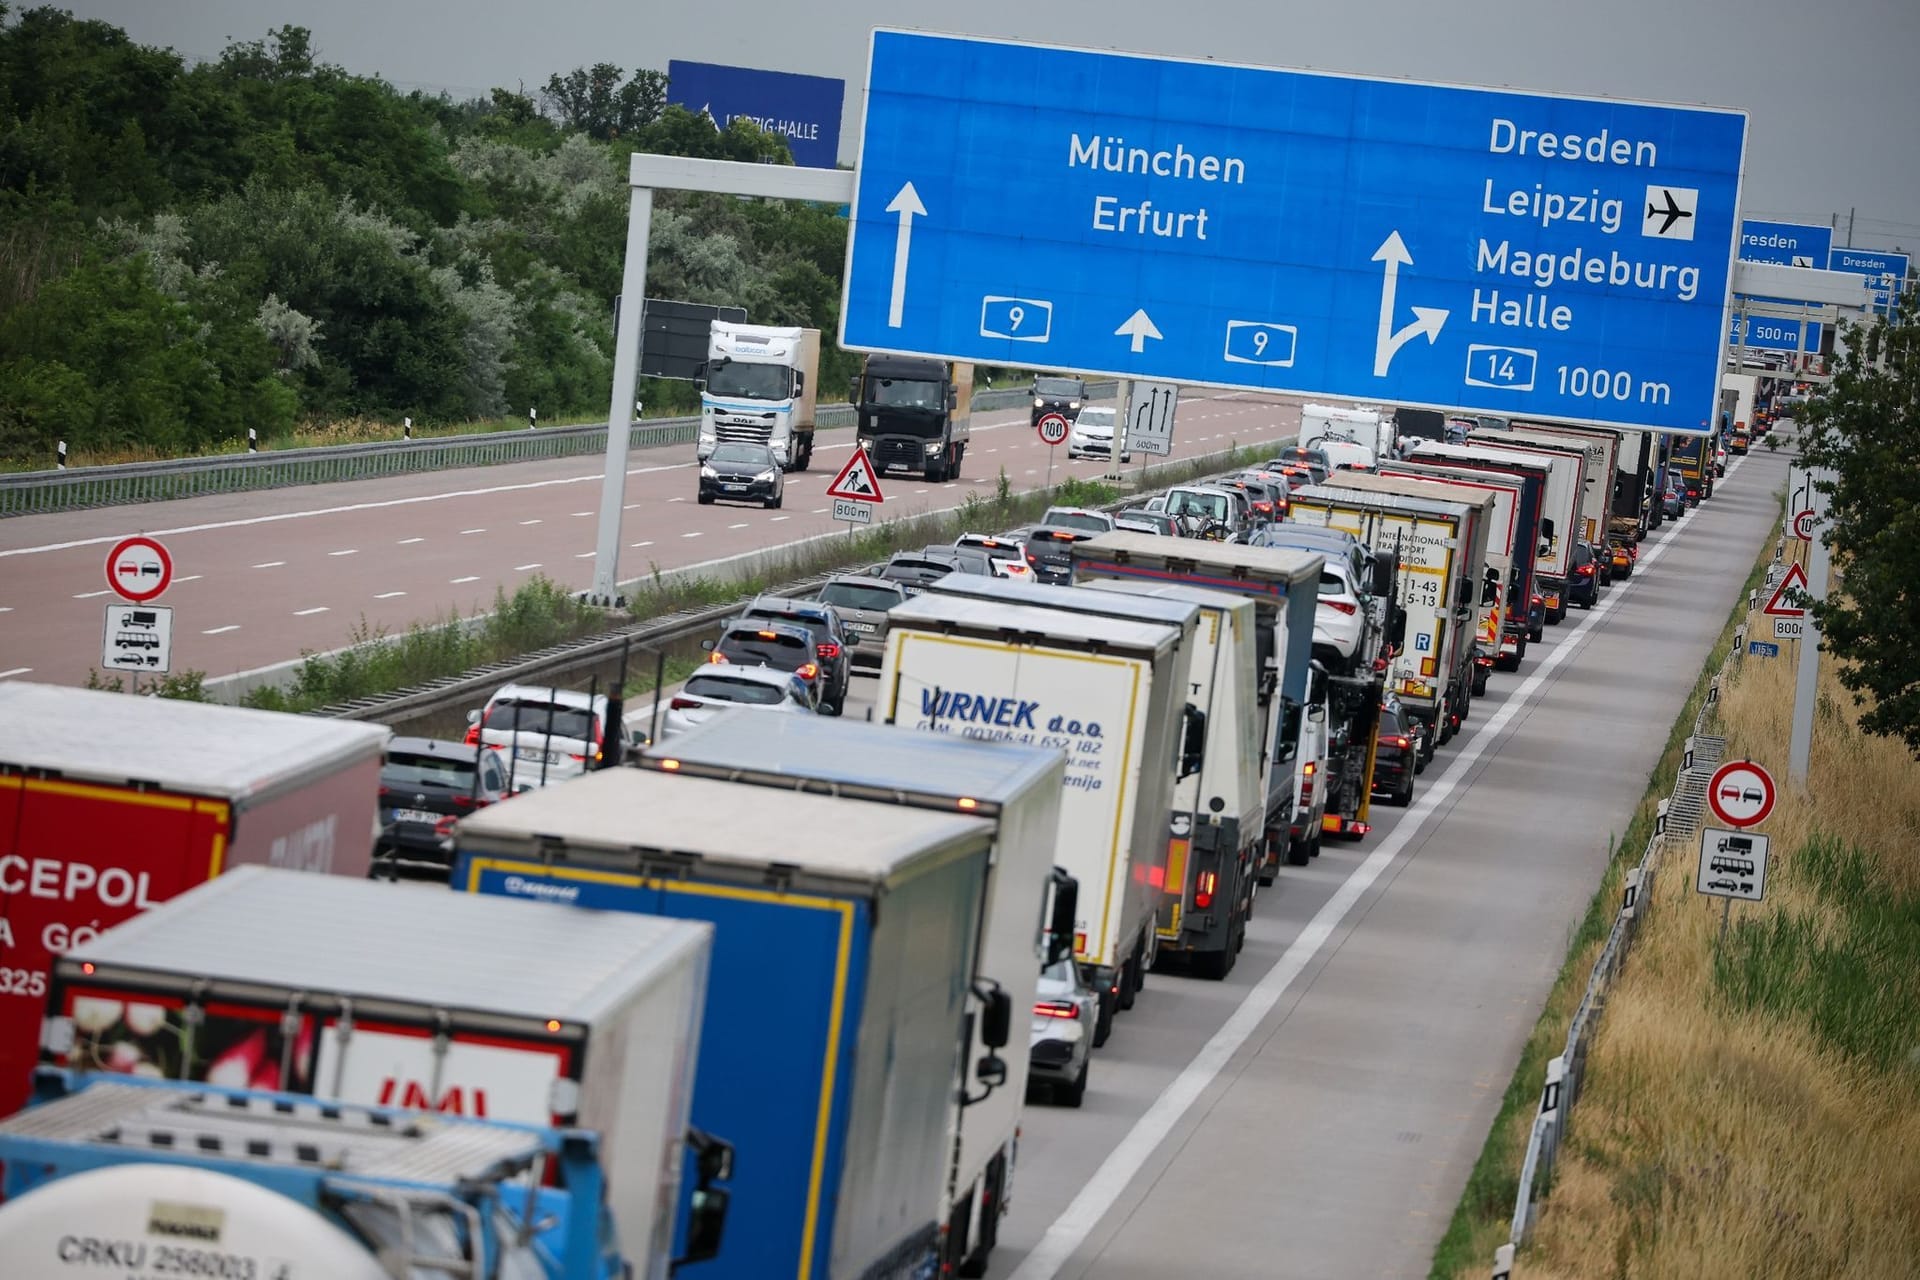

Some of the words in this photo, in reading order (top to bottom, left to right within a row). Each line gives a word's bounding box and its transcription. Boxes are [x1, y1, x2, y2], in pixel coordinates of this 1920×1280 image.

[1489, 118, 1657, 168] Dresden
[1068, 133, 1246, 184] München
[1092, 195, 1209, 240] Erfurt
[1483, 179, 1623, 234] Leipzig
[1741, 233, 1797, 250] resden
[1476, 239, 1701, 301] Magdeburg
[1842, 256, 1886, 270] Dresden
[1009, 306, 1024, 332] 9
[1470, 289, 1572, 331] Halle
[1253, 331, 1269, 356] 9
[1756, 326, 1782, 341] 500
[1783, 331, 1797, 343] m
[1488, 354, 1516, 382] 14
[1558, 366, 1632, 401] 1000
[1639, 381, 1671, 405] m
[1043, 422, 1063, 437] 100
[1377, 542, 1425, 554] TRASPORT
[1379, 531, 1444, 547] INTENATIONAL
[1777, 622, 1802, 635] 800
[921, 687, 1040, 730] VIRNEK
[1047, 714, 1104, 739] d.o.o.
[1075, 740, 1103, 754] 182
[0, 854, 163, 910] CEPOL
